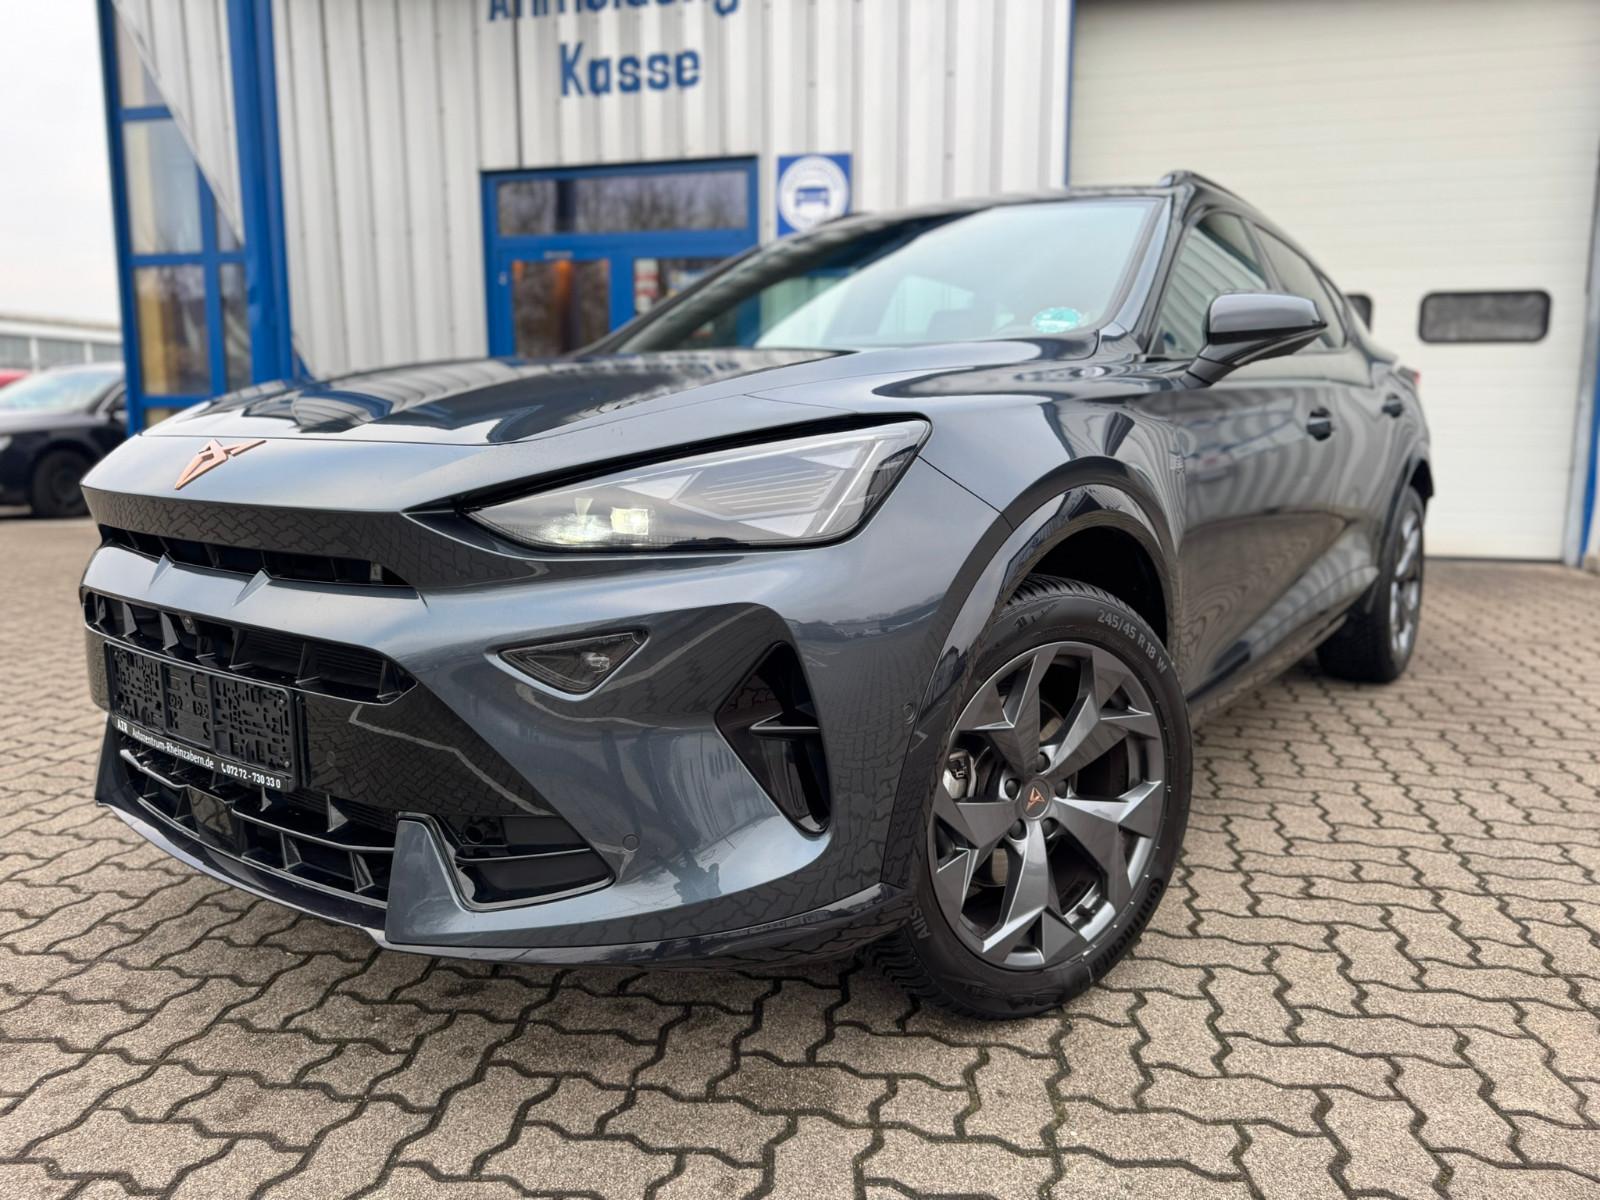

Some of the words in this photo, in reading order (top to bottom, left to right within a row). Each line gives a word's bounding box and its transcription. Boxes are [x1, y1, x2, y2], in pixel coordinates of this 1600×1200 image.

[559, 41, 702, 97] Kasse
[1097, 609, 1137, 640] 245/45
[1137, 633, 1146, 649] R
[1145, 642, 1157, 660] 18
[1156, 656, 1168, 674] W
[117, 719, 128, 734] AZR
